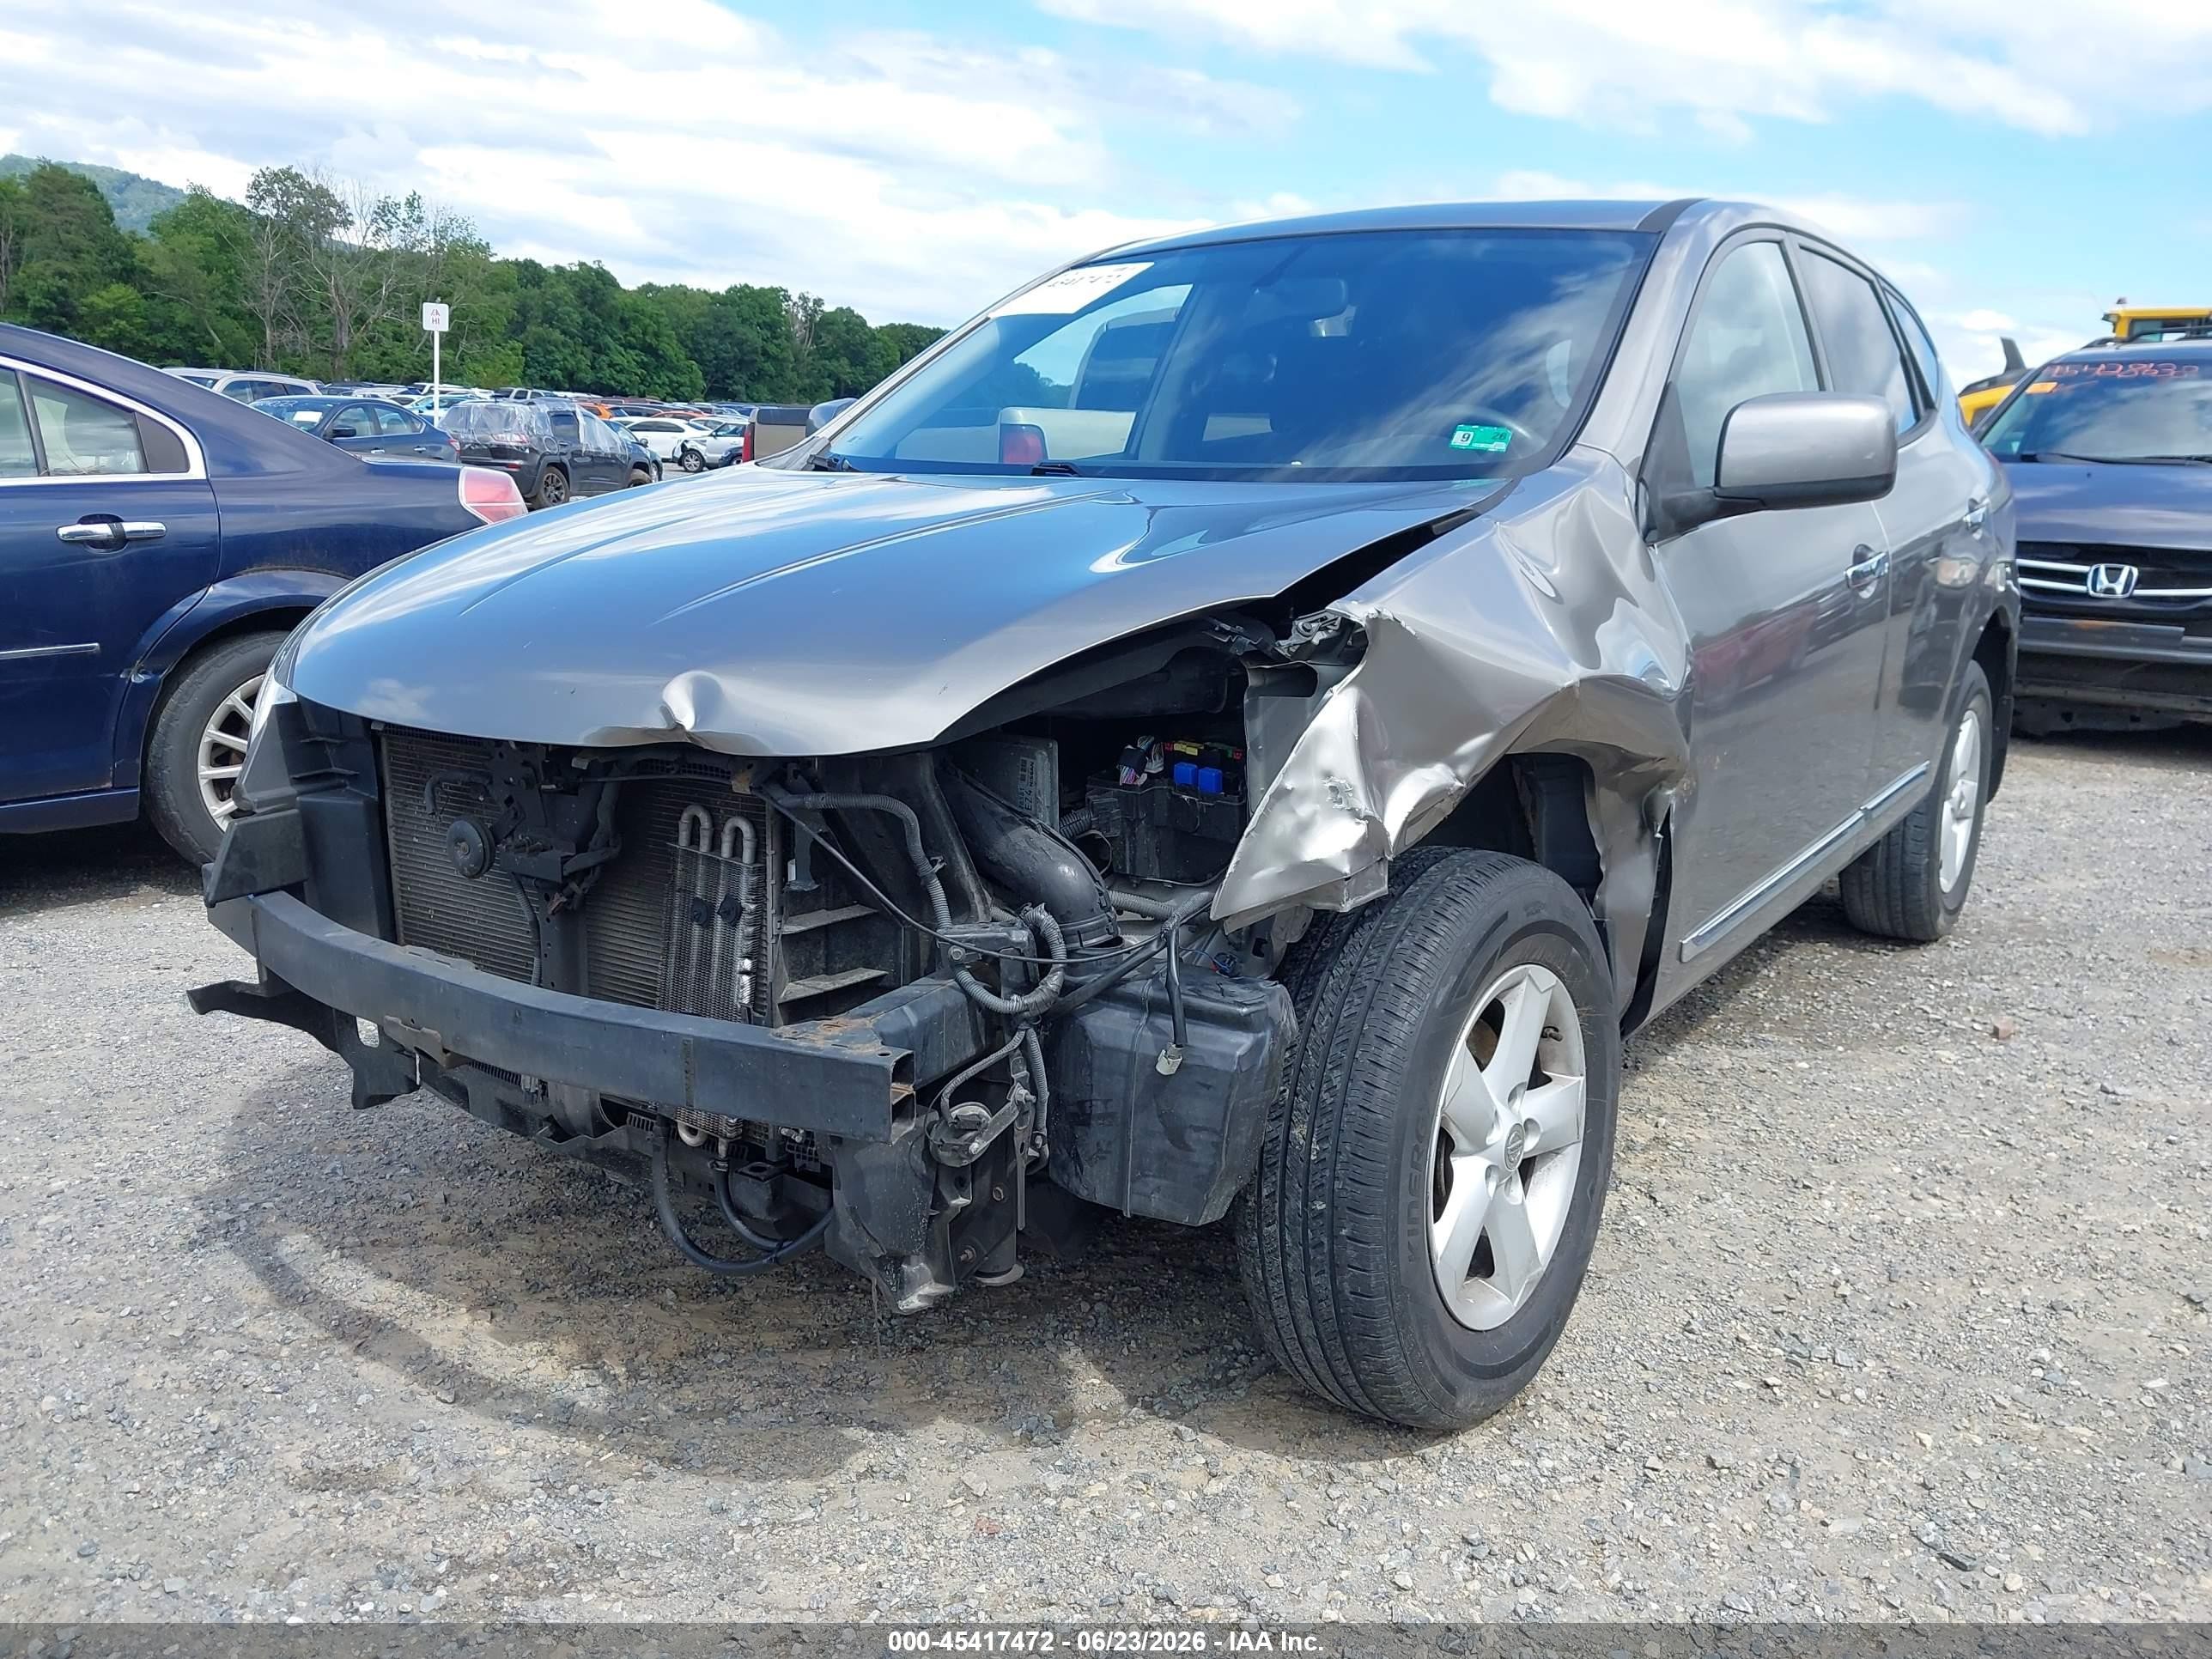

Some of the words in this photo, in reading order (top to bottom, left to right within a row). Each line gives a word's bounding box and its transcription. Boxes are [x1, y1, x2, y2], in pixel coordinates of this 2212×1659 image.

[1461, 433, 1471, 442] 9
[1492, 432, 1507, 441] 26
[1407, 1102, 1431, 1263] KINERG
